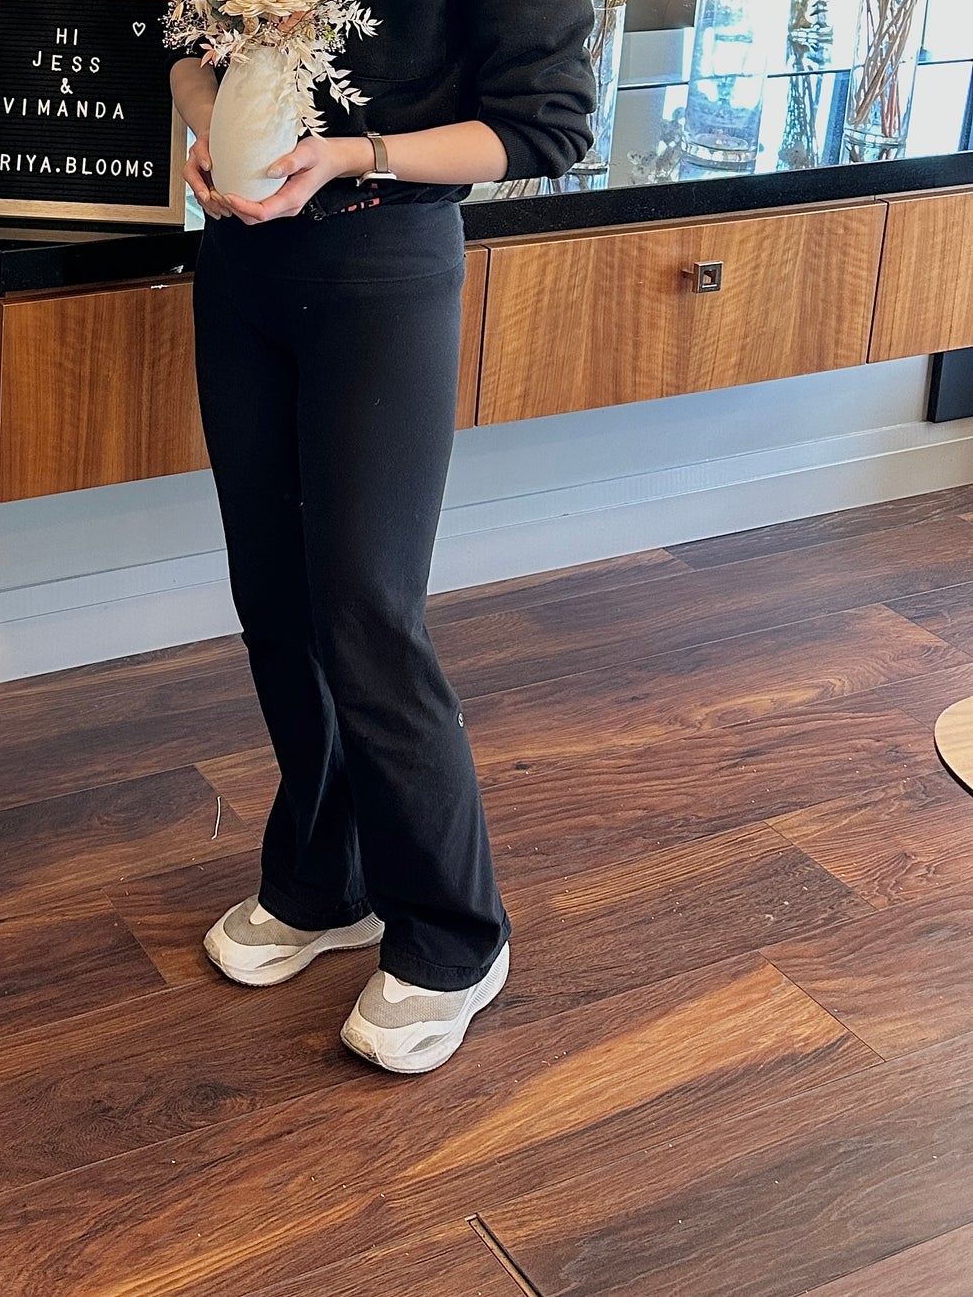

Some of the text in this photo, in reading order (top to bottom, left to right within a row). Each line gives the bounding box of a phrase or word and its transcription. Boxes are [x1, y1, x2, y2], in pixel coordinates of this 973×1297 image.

[55, 27, 78, 46] HI
[32, 50, 101, 74] JESS
[59, 77, 74, 95] &
[2, 96, 125, 120] VIMANDA
[0, 153, 154, 178] RIYA.BLOOMS
